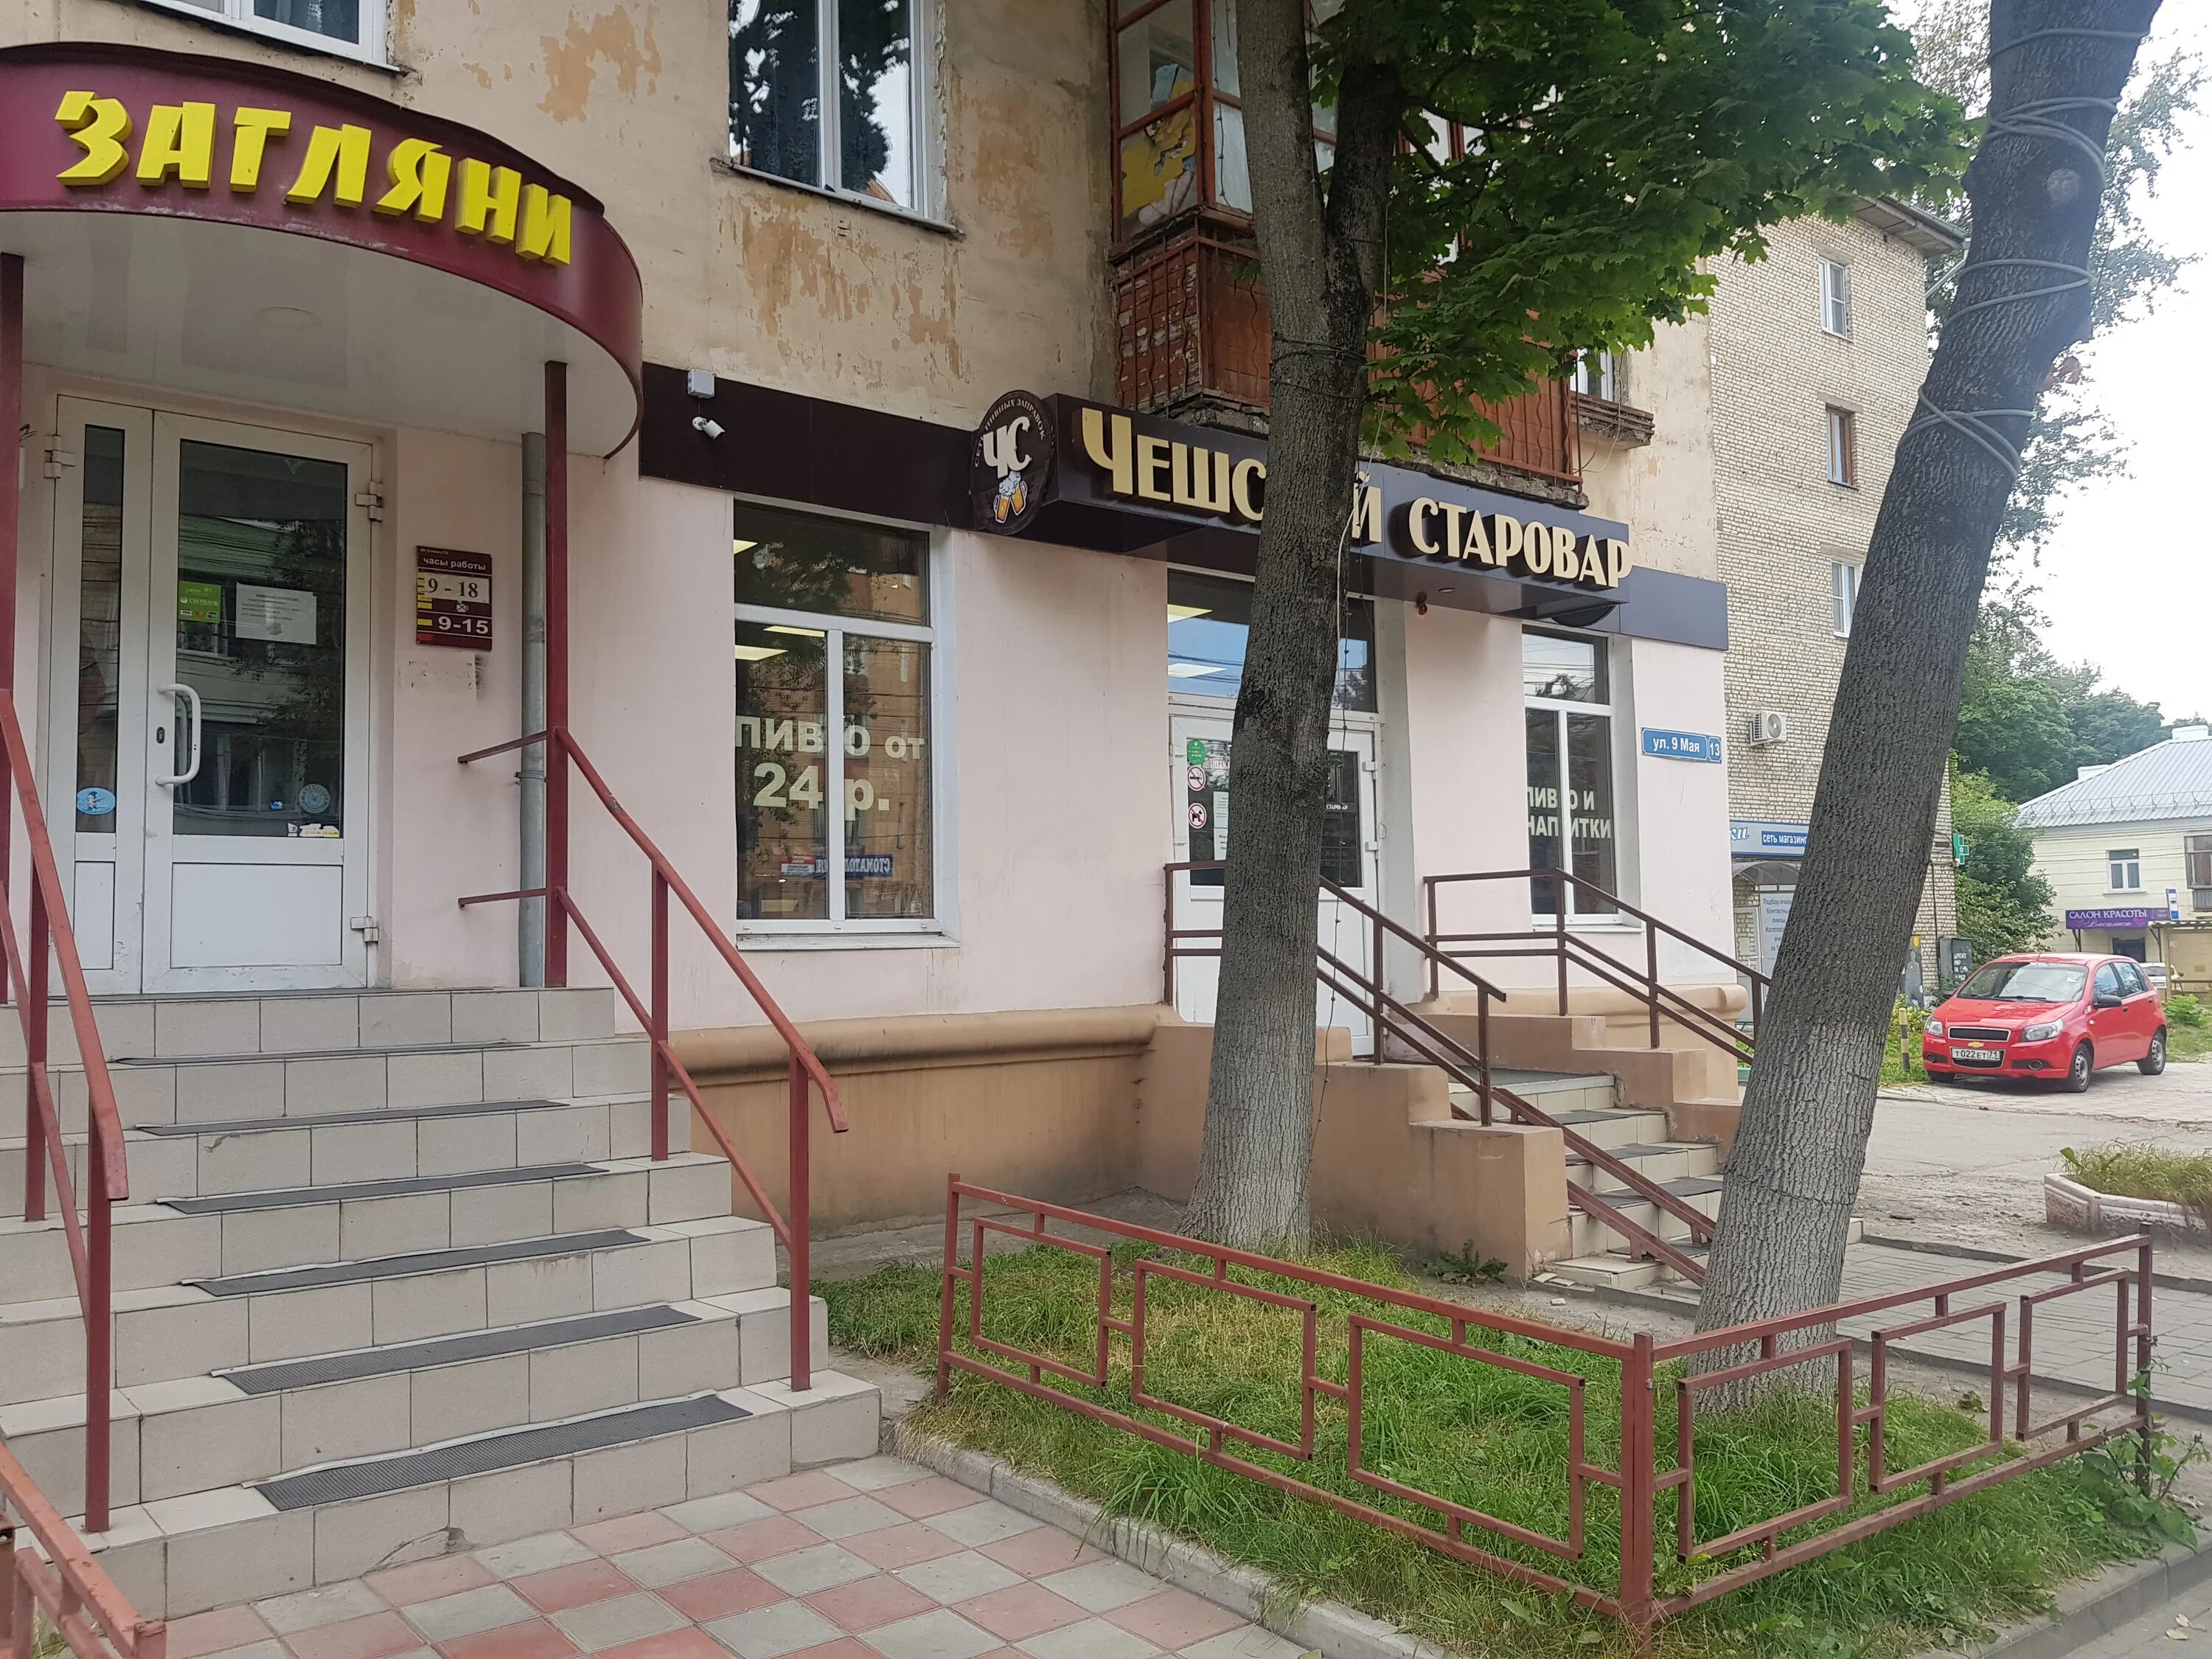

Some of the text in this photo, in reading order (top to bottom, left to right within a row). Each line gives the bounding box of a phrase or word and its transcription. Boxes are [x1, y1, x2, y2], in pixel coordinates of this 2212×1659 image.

[55, 90, 571, 265] ЗАГЛЯНИ
[984, 399, 1015, 431] ПИВНЫХ
[1016, 398, 1046, 441] ЗАПРАВОК
[983, 416, 1032, 479] ЧС
[1082, 407, 1632, 588] ЧЕШСЙ СТАРОВАР
[423, 557, 486, 571] часы работы
[428, 578, 439, 594] 9
[458, 581, 478, 598] 18
[438, 616, 489, 634] 9-15
[736, 715, 925, 759] ПИВО от
[1652, 737, 1720, 757] ул. 9 Мая 13
[753, 762, 890, 821] 24 р.
[1583, 790, 1595, 810] И
[1762, 834, 1778, 843] сеть
[2068, 909, 2147, 919] САЛОН КРАСОТЫ
